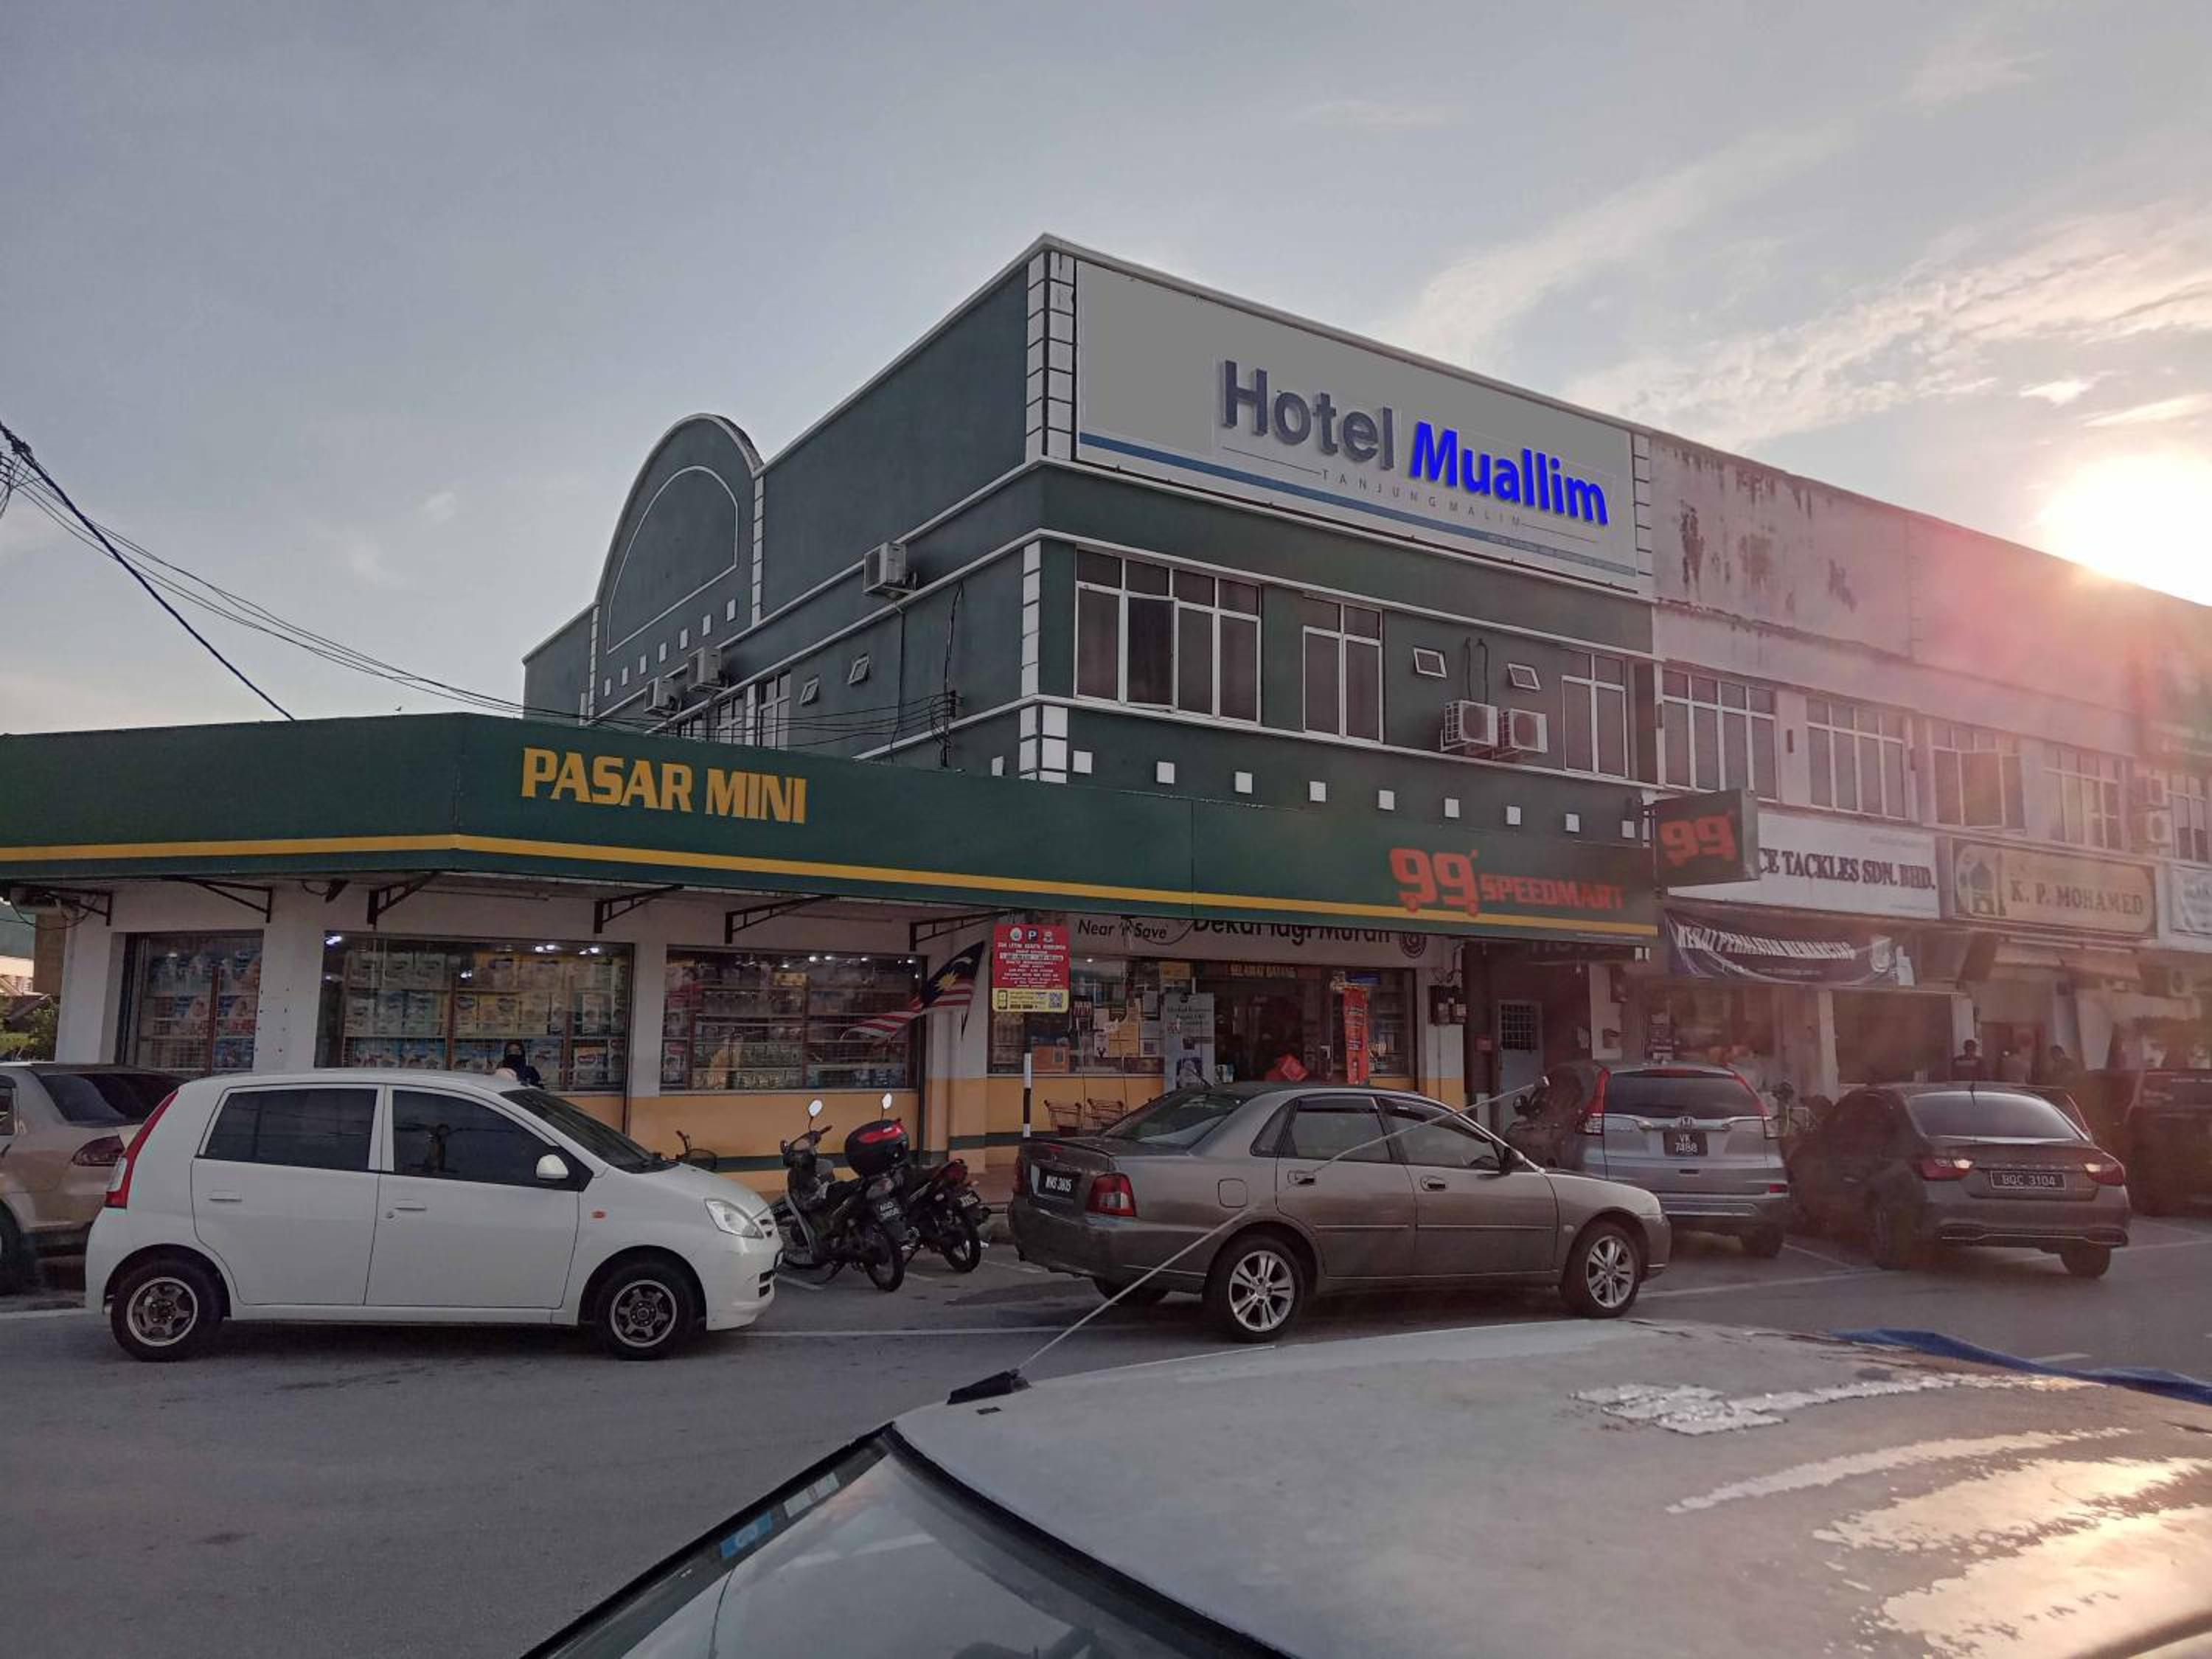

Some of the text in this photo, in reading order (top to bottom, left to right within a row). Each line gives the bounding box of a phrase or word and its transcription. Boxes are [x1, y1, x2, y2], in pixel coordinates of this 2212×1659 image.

[1221, 360, 1608, 525] Hotel Muallim
[521, 747, 807, 824] PASAR MINI
[1660, 812, 1738, 867] 99
[1389, 848, 1624, 917] 99 SPEEDMART
[1782, 850, 1859, 882] TACKLES
[1863, 859, 1898, 886] SDN.
[1078, 919, 1116, 936] Near
[2056, 885, 2143, 915] MOHAMED
